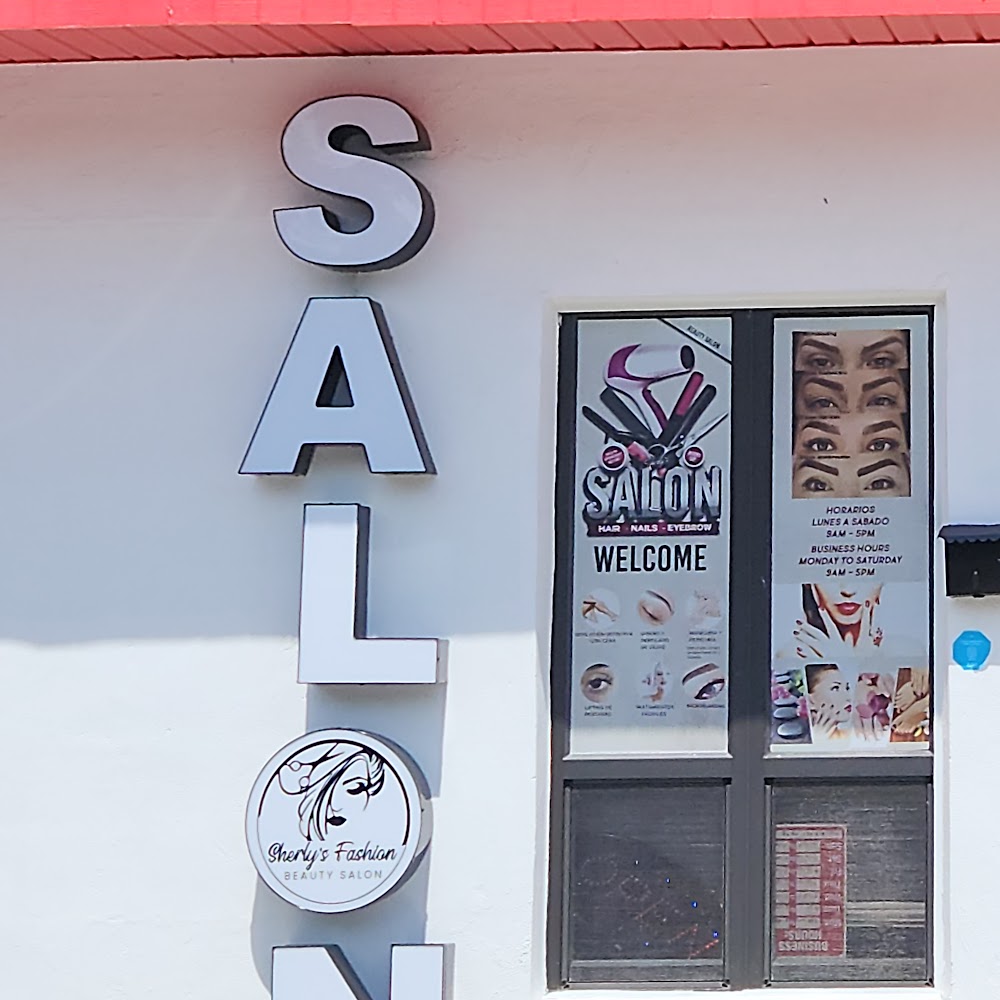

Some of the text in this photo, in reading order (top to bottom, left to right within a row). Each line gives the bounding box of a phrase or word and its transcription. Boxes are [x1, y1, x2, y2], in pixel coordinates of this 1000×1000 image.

[583, 465, 721, 520] SALON
[826, 505, 876, 514] HORARIOS
[812, 517, 890, 527] LUNES A SABADO
[598, 525, 621, 533] HAIR
[630, 524, 658, 532] NAILS
[667, 523, 712, 532] EYEBROW
[826, 530, 846, 538] 9AM
[855, 529, 875, 537] 5PM
[811, 543, 890, 553] BUSINESS HOURS
[594, 544, 707, 573] WELCOME
[799, 555, 902, 565] MONDAY TO SATURDAY
[826, 569, 846, 577] 9AM
[855, 567, 875, 576] 5PM
[268, 841, 397, 870] Sherly's Fashion
[284, 869, 382, 881] BEAUTY SALON
